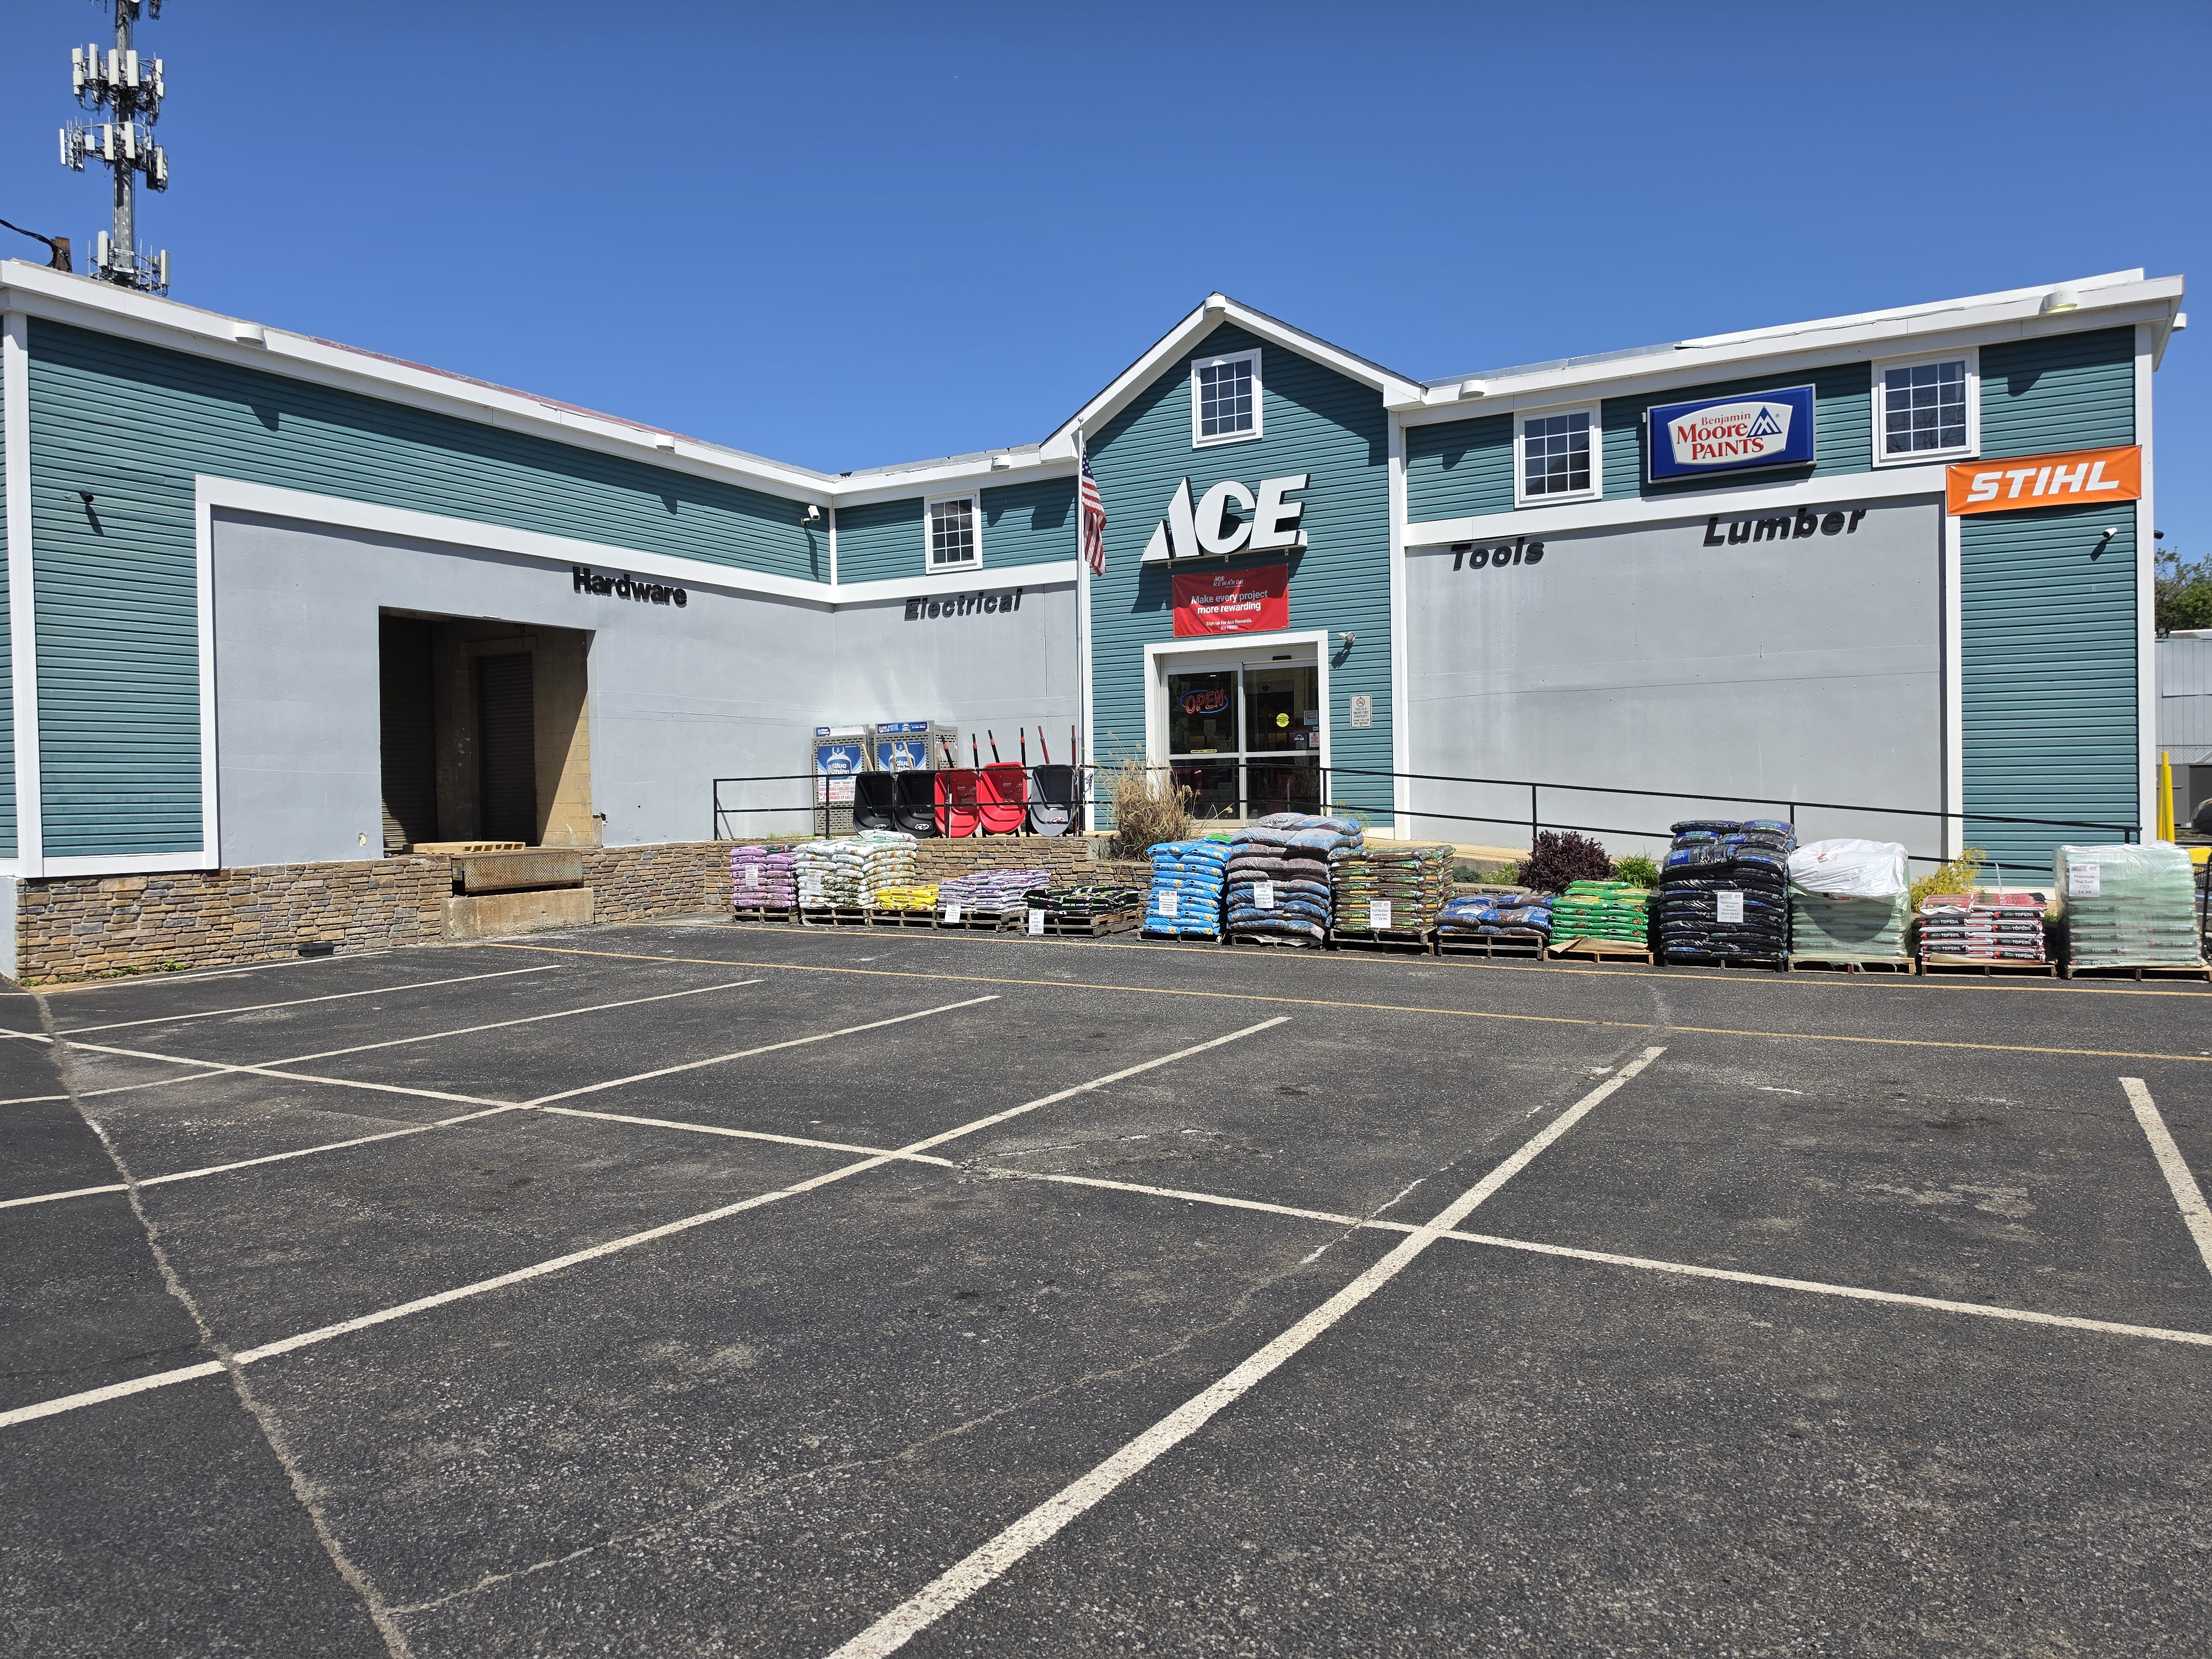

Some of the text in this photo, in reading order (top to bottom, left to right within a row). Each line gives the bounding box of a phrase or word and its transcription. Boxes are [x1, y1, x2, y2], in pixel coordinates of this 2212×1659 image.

[1677, 422, 1748, 444] Moore
[1702, 412, 1750, 425] Benjamin
[1692, 437, 1764, 460] PAINTS
[1966, 461, 2120, 502] STIHL
[1139, 473, 1311, 562] ACE
[1703, 507, 1867, 546] Lumber
[1451, 536, 1545, 572] Tools
[572, 566, 687, 608] Hardware
[1191, 589, 1268, 604] Make every project
[904, 588, 1023, 621] Electrical
[1220, 601, 1261, 613] rewarding
[1185, 689, 1224, 714] OPEN
